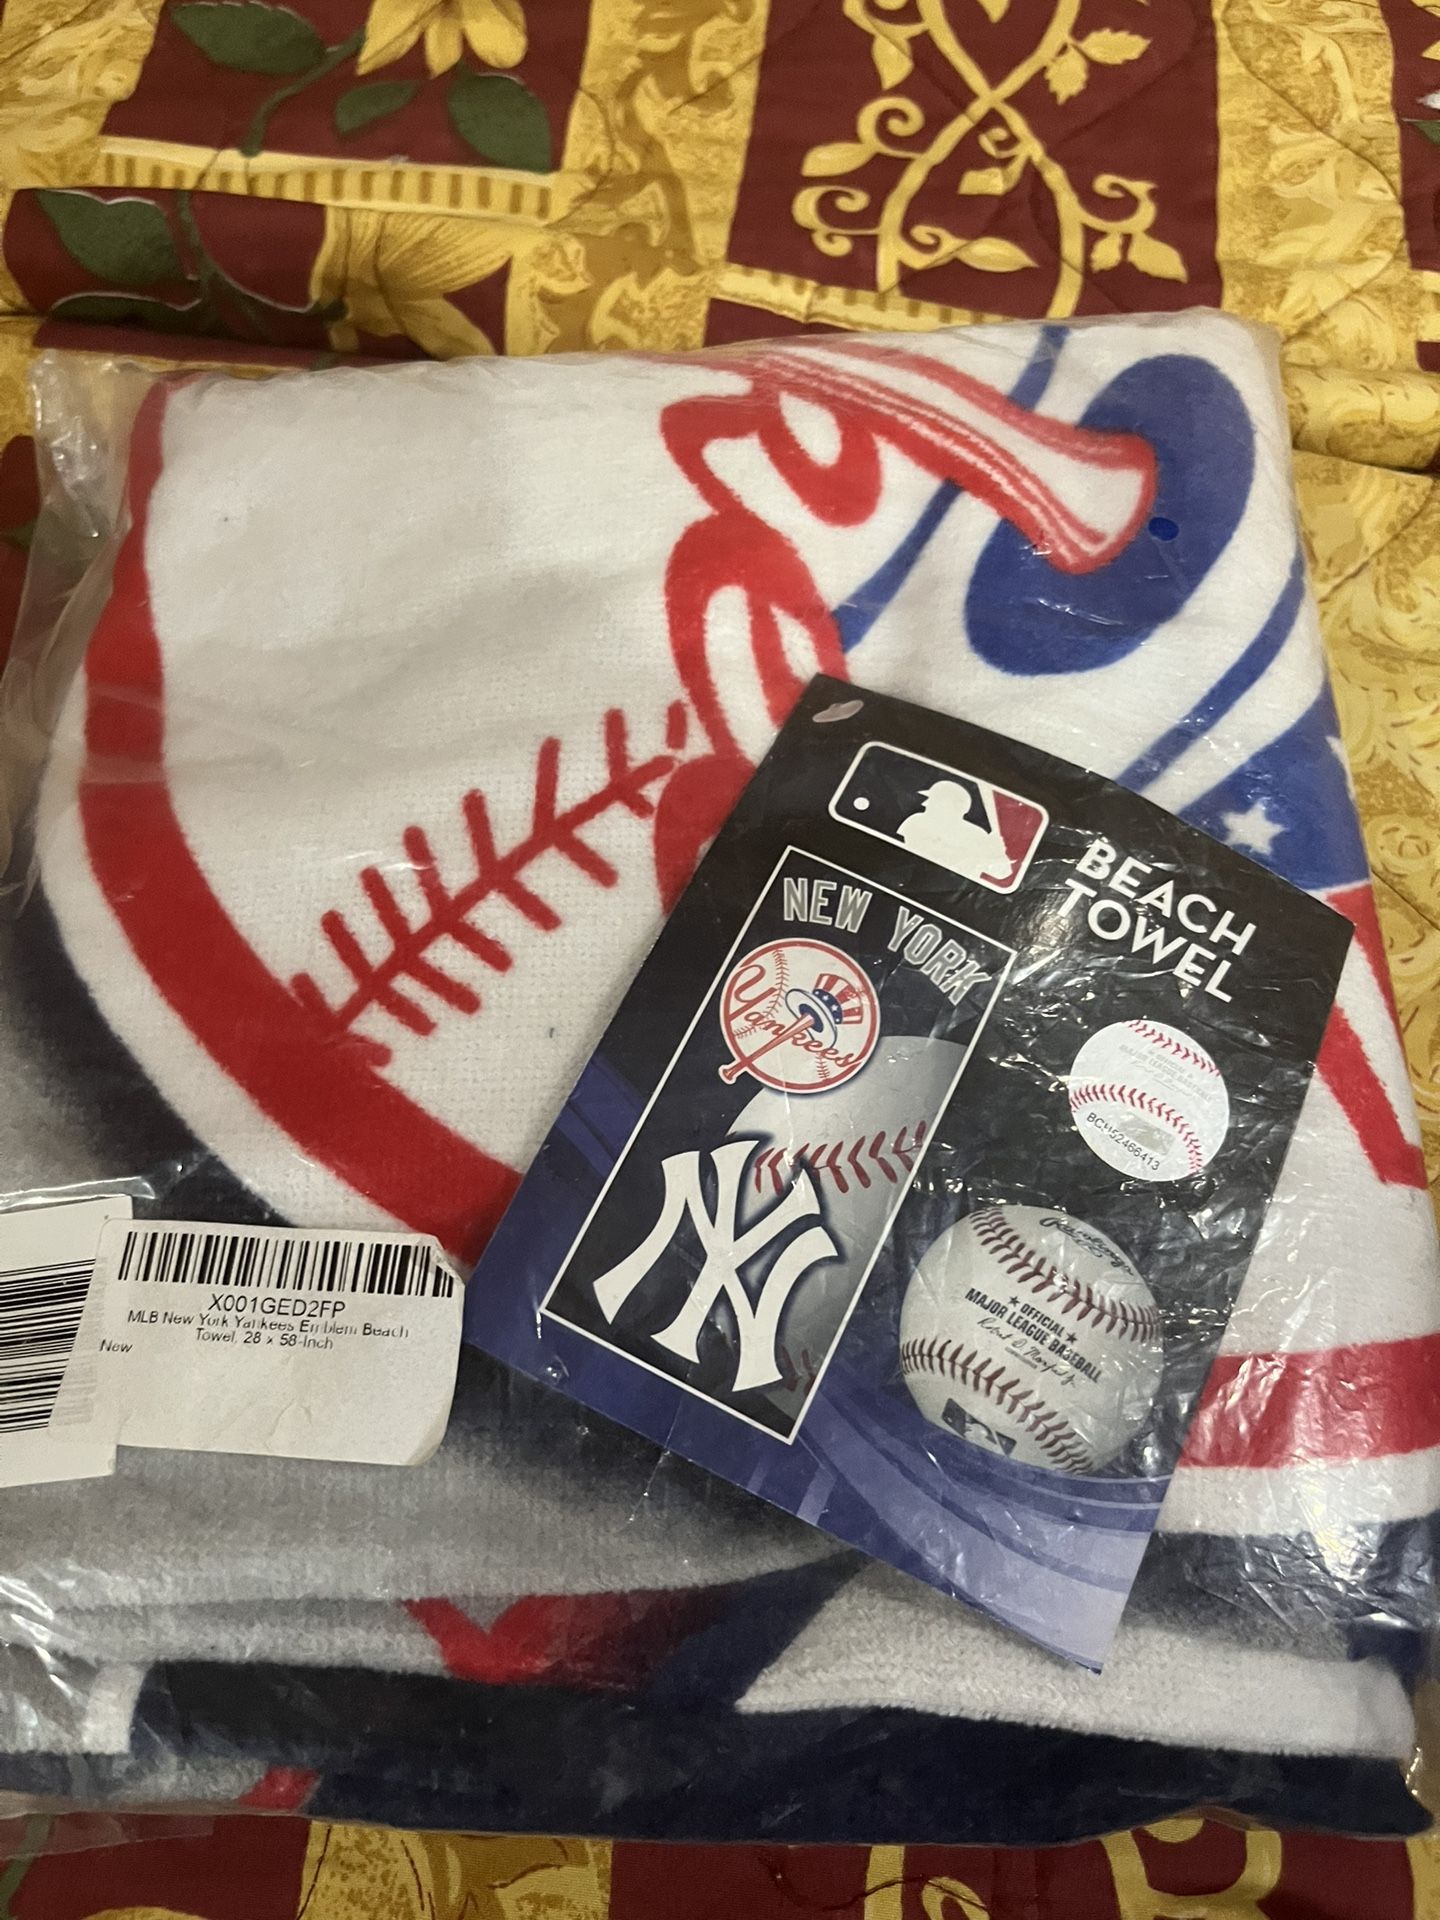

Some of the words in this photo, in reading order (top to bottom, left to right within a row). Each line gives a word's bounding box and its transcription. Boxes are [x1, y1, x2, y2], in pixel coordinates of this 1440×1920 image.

[1075, 838, 1257, 956] BEACH
[783, 877, 873, 933] NEW
[887, 905, 992, 1006] YORK
[1057, 878, 1232, 1003] TOWEL
[208, 1293, 346, 1318] X001GED2FP
[1020, 1303, 1065, 1337] OFFICIAL
[128, 1310, 159, 1324] MLB
[162, 1311, 195, 1325] New
[199, 1313, 229, 1328] York
[235, 1315, 295, 1332] Yankees
[299, 1320, 357, 1335] Emblem
[362, 1323, 409, 1338] Beach
[243, 1331, 262, 1345] 28
[279, 1333, 334, 1350] 58-Inch
[965, 1288, 1008, 1319] MAJOR
[1006, 1311, 1050, 1346] LEAGUE
[1048, 1338, 1101, 1383] BASEBALL
[99, 1339, 133, 1353] New
